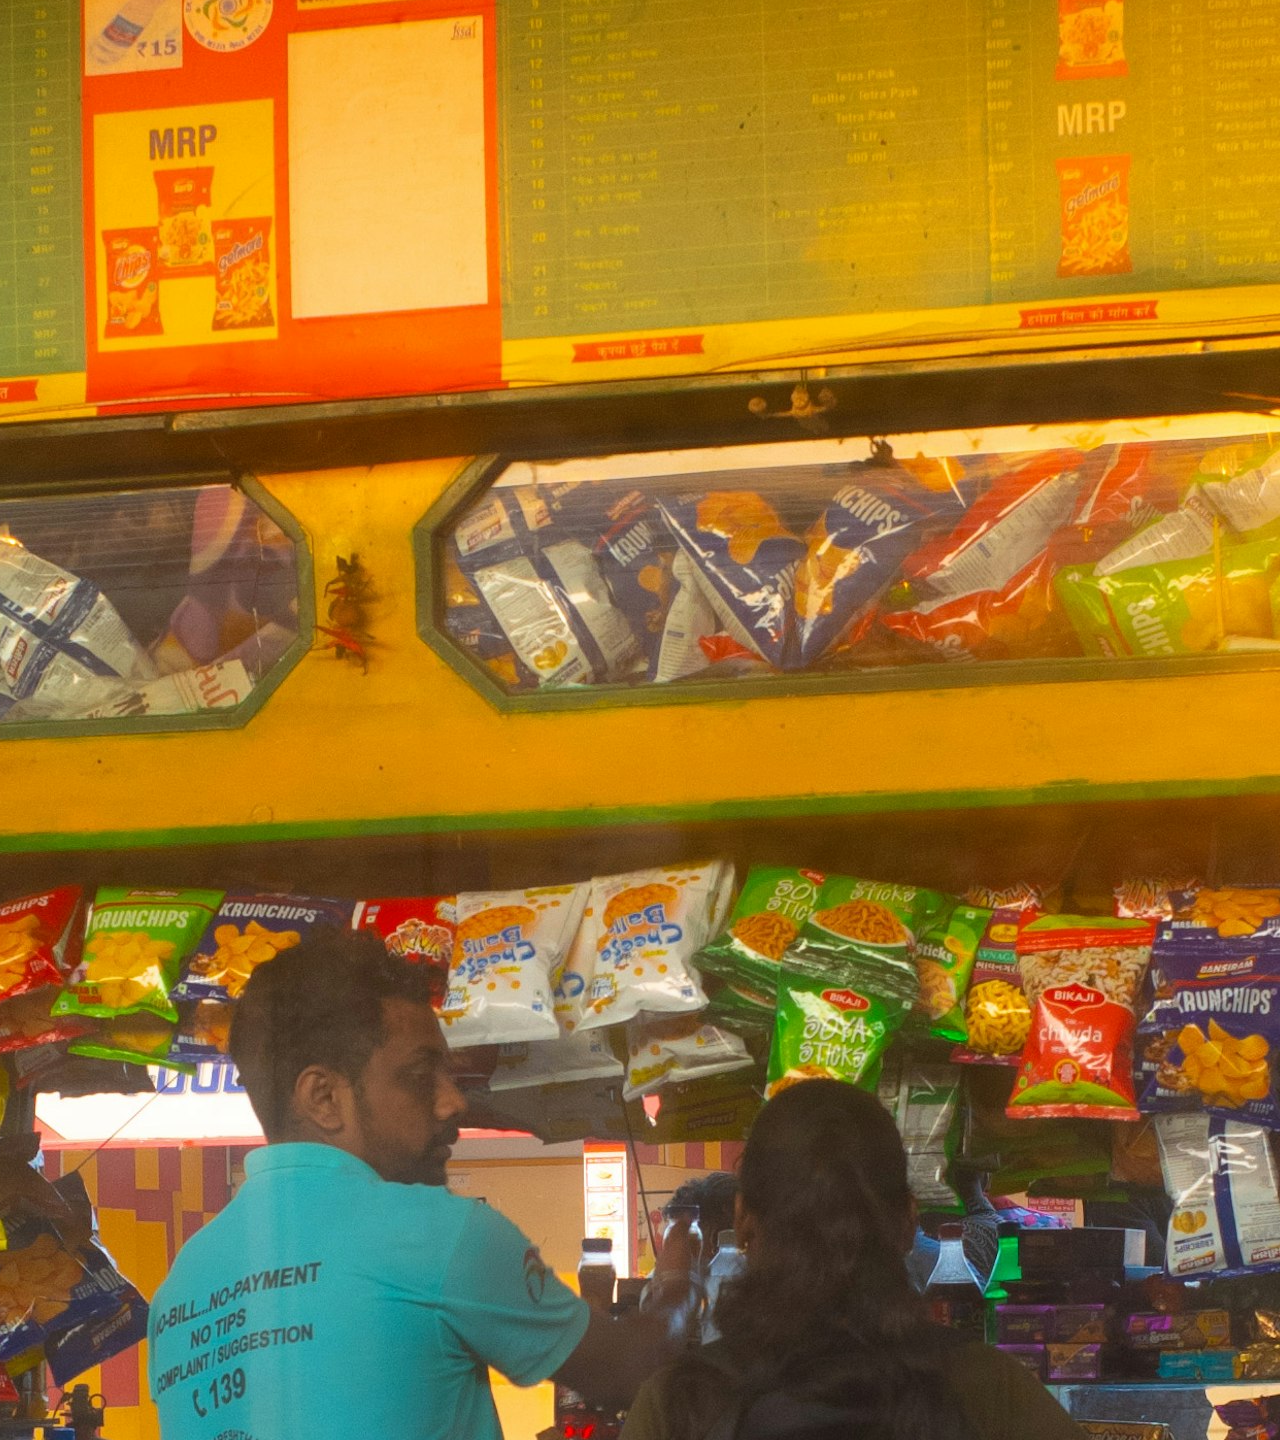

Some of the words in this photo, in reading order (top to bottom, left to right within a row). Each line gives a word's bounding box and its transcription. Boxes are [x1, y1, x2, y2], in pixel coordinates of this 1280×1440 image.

[1057, 101, 1126, 137] MRP
[149, 124, 217, 161] MRP
[218, 901, 318, 923] KRUNCHIPS
[1053, 990, 1095, 1003] BIKAJI
[798, 1040, 868, 1068] STICKS
[190, 1325, 213, 1350] NO
[215, 1308, 247, 1338] TIPS
[208, 1367, 247, 1411] 139
